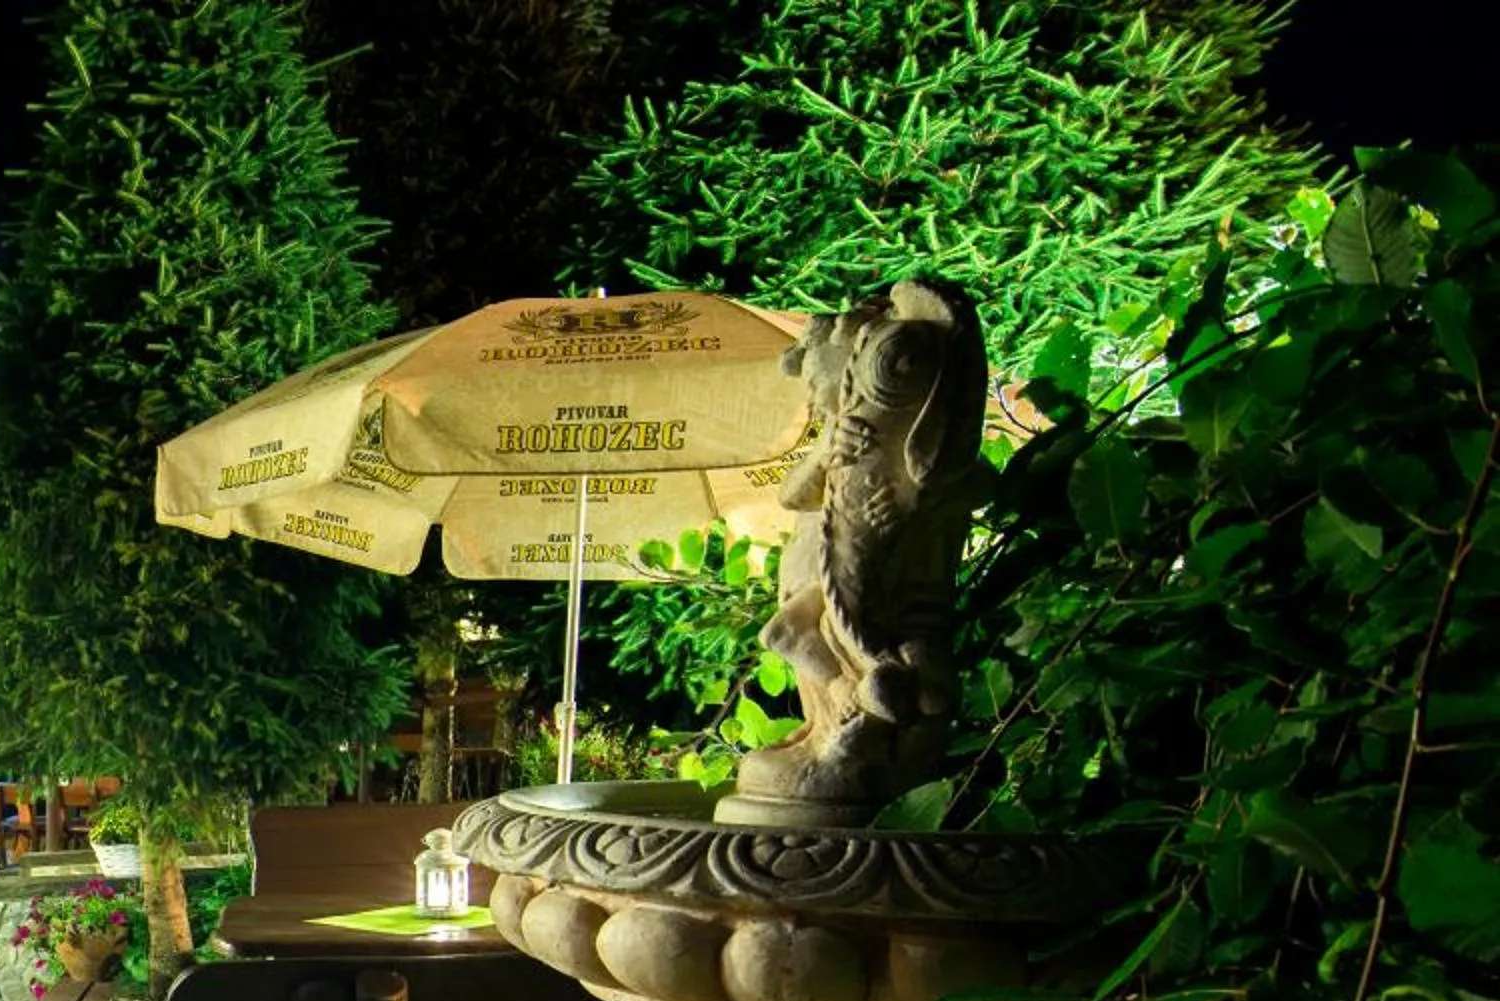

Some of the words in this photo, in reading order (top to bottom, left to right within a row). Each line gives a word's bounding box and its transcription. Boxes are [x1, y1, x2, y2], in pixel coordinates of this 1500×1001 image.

[479, 336, 722, 362] ROHOZEC
[556, 404, 629, 421] PIVOVAR
[496, 420, 687, 454] ROHOZEC
[218, 447, 308, 490] ROHOZEC
